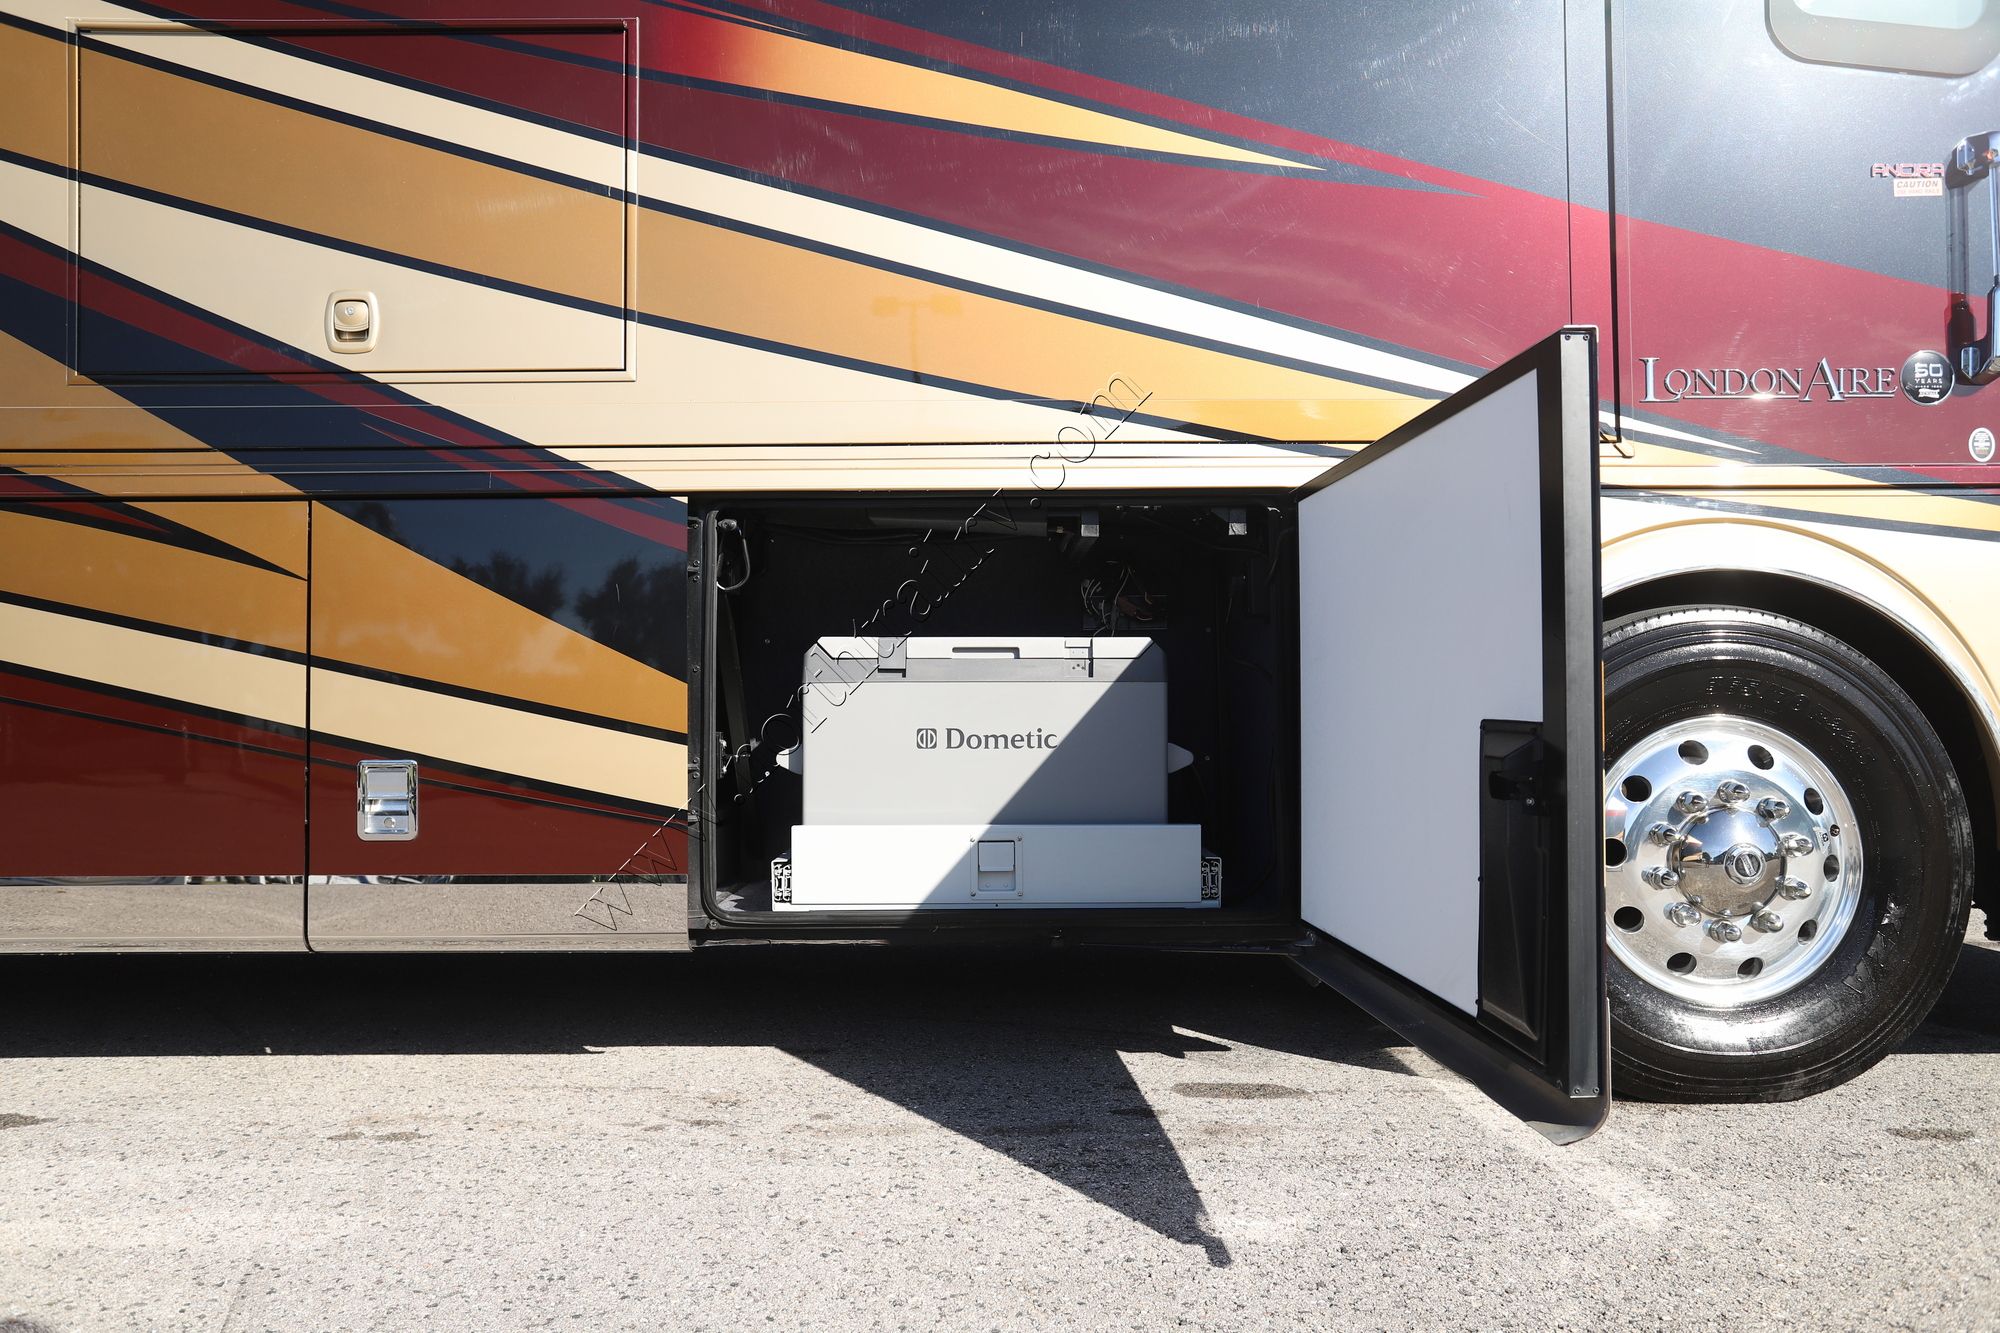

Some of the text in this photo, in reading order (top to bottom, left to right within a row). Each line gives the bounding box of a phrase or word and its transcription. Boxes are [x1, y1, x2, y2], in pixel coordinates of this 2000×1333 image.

[1896, 180, 1939, 189] CAUTION
[1914, 362, 1944, 378] 50
[945, 727, 1058, 749] Dometic
